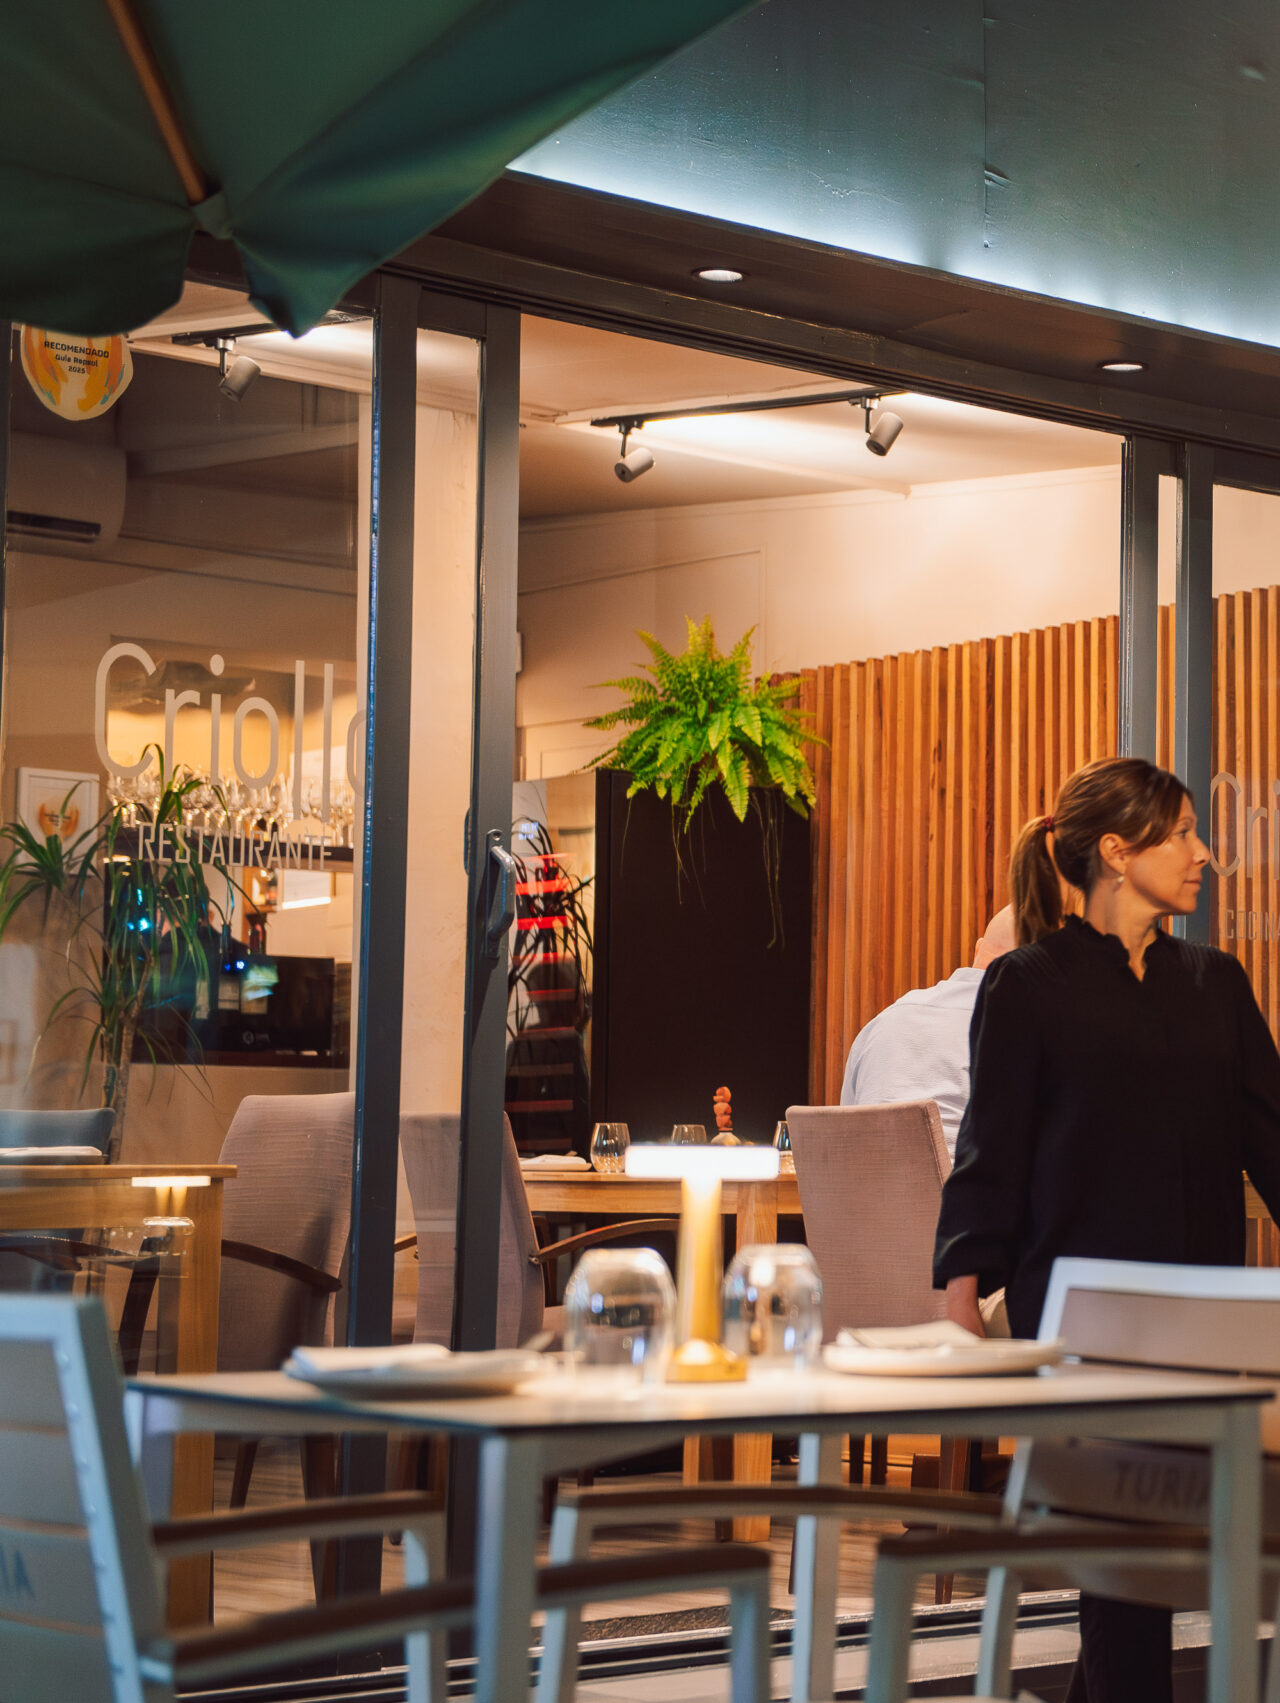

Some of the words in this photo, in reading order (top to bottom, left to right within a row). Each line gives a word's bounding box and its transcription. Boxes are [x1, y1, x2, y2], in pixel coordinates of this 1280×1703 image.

[44, 341, 109, 358] RECOMENDADO
[73, 357, 98, 368] Repsol
[68, 366, 86, 374] 2025
[138, 822, 332, 870] RESTAURANTE
